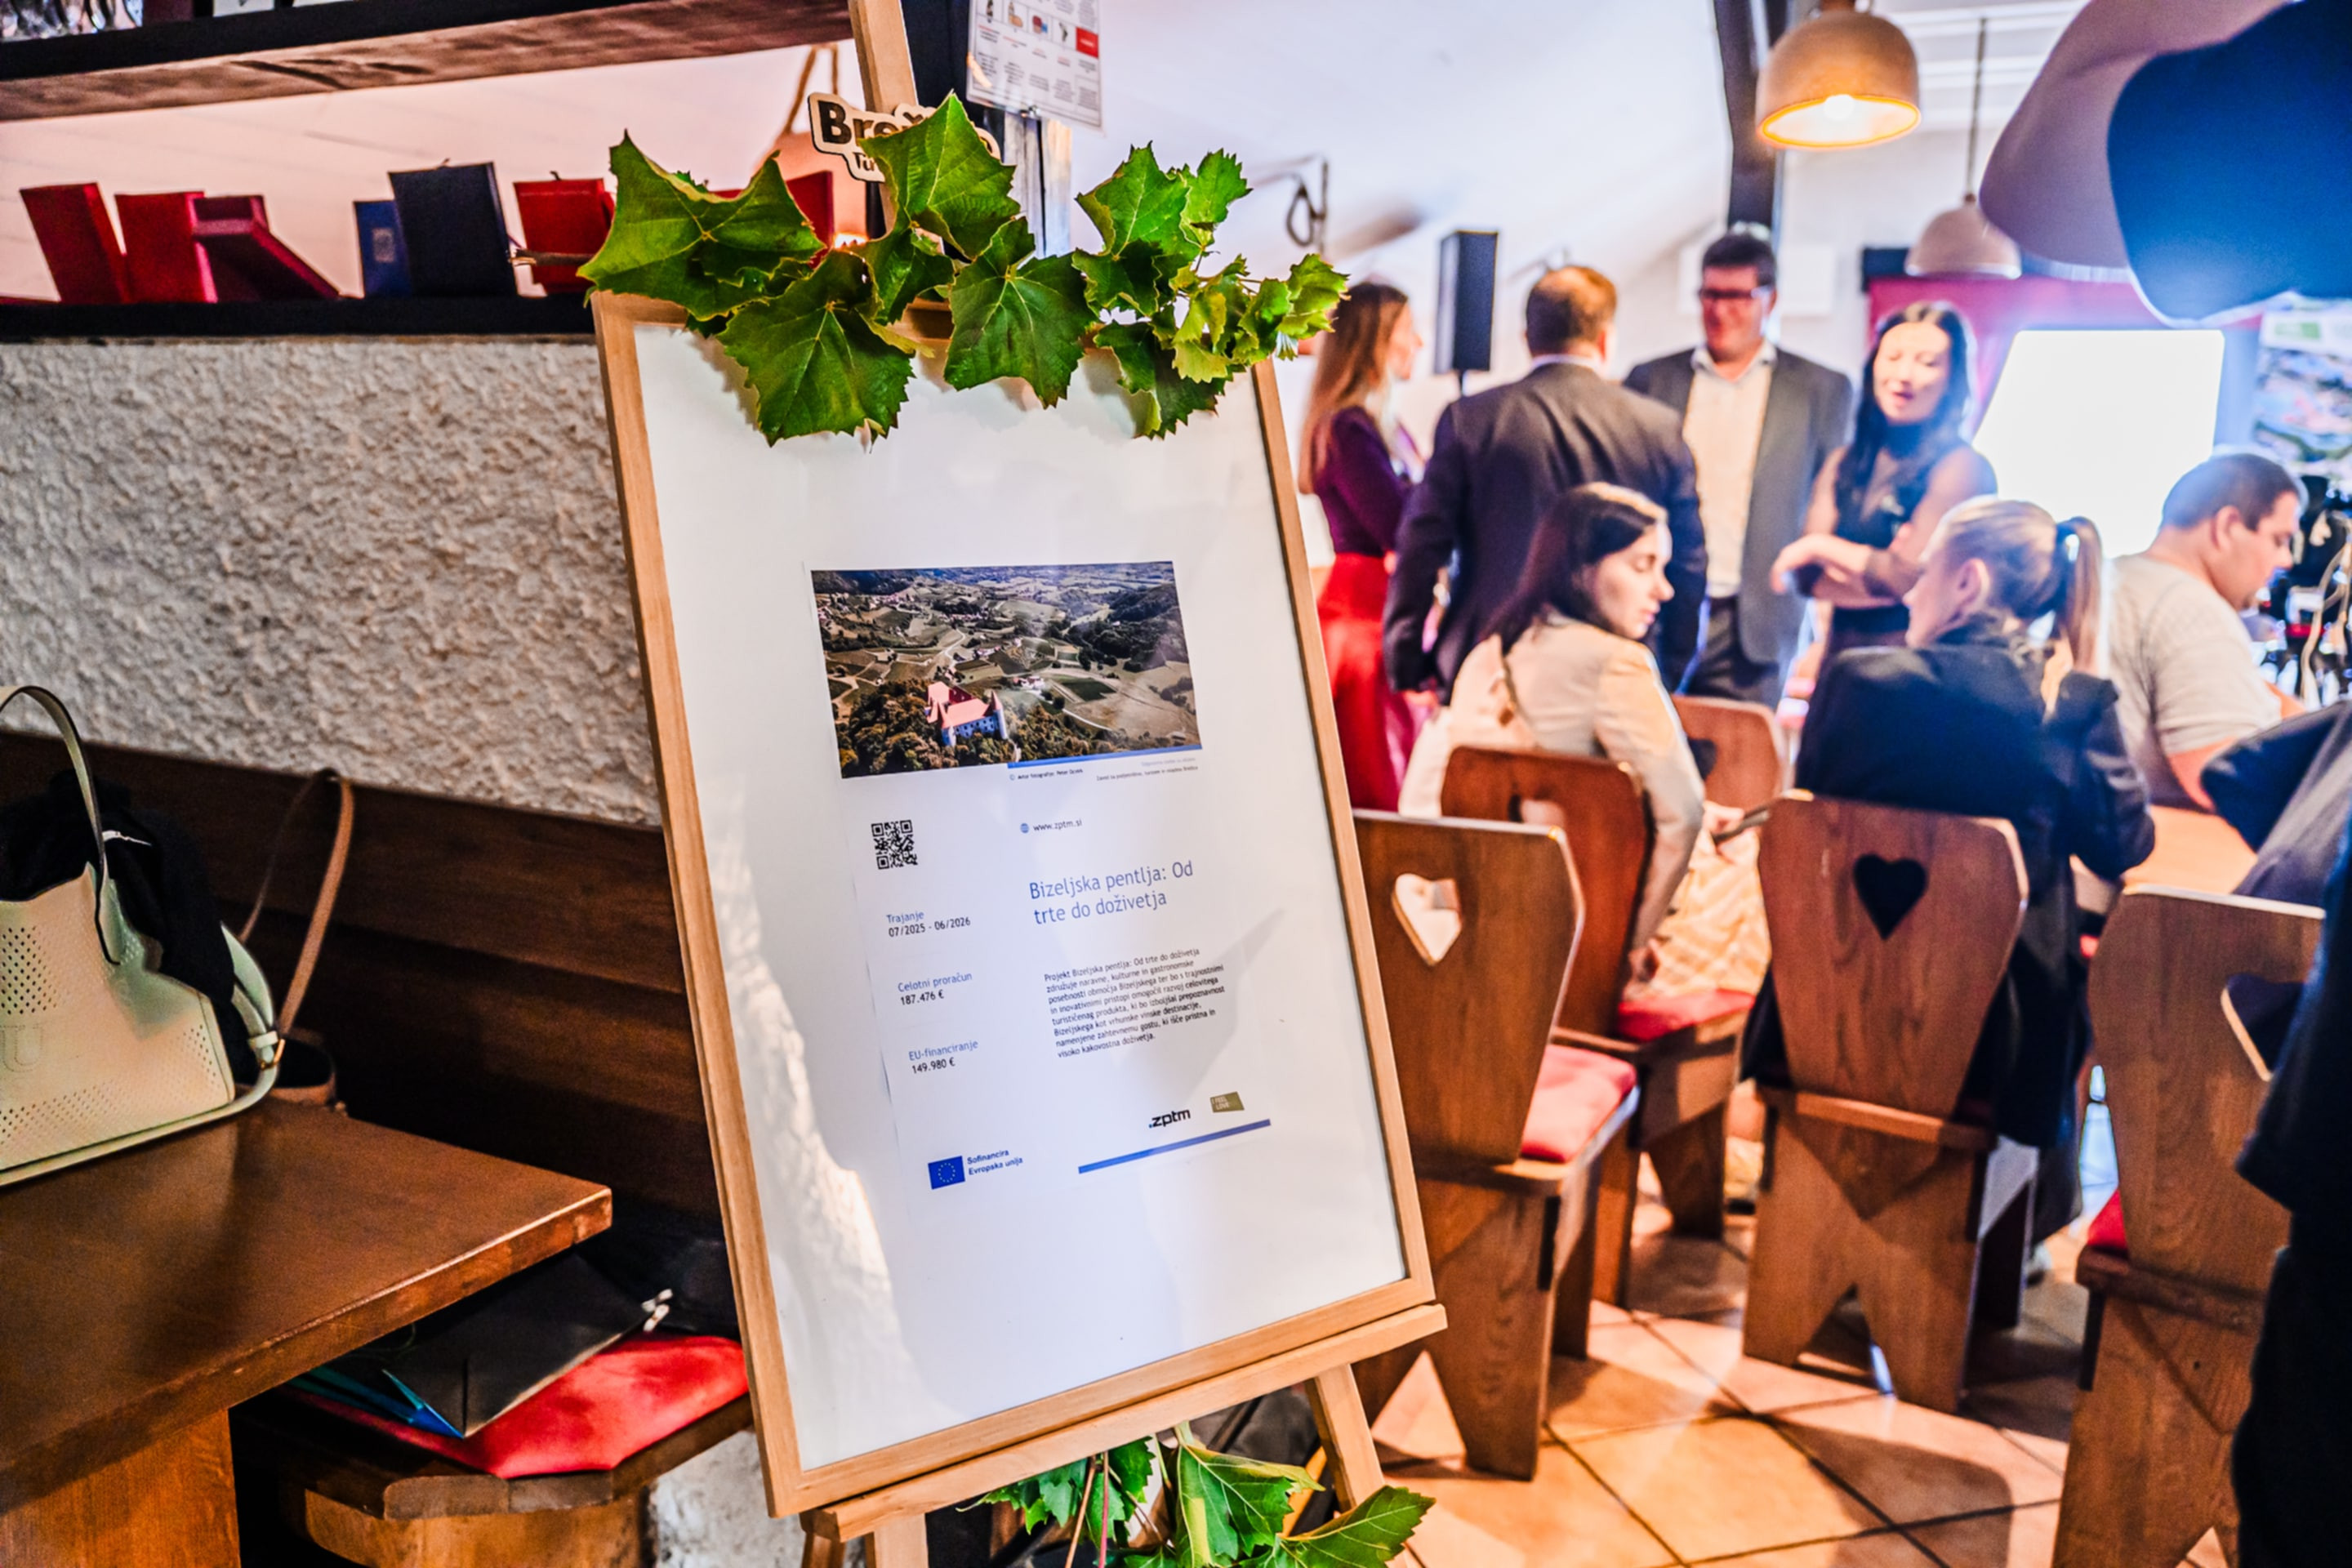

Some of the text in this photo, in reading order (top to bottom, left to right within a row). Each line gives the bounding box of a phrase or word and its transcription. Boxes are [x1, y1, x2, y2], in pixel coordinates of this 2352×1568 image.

[1033, 818, 1082, 832] www.zptm.si
[1029, 860, 1193, 899] Bizeljska pentlja: Od
[886, 911, 924, 924] Trajanje
[1034, 890, 1167, 924] trte do doživetja
[889, 923, 926, 938] 07/2025
[934, 916, 971, 930] 06/2026
[1045, 948, 1200, 982] Projekt Bizeljska pentlja: Od trte do doživetja
[898, 972, 973, 992] Celotni proračun
[1047, 981, 1077, 993] združuje
[1079, 977, 1110, 987] naravne,
[1111, 970, 1140, 981] kulturne
[1150, 960, 1194, 975] gastronomske
[1049, 991, 1086, 1004] posebnosti
[1088, 985, 1117, 996] območja
[1119, 978, 1156, 991] Bizeljskega
[1158, 975, 1168, 983] ter
[1169, 973, 1178, 981] bo
[1185, 964, 1223, 978] trajnostnimi
[901, 989, 944, 1005] 187.476 €
[1050, 977, 1218, 1014] in inovativnimi pristopi omogočil razvoj celovitega
[1095, 1004, 1129, 1018] produkta,
[1138, 1000, 1147, 1009] bo
[1149, 993, 1177, 1006] izboljšal
[1178, 986, 1225, 1001] prepoznavnost
[1054, 1022, 1094, 1036] Bizeljskega
[1095, 1019, 1107, 1028] kot
[1109, 1013, 1138, 1025] vrhunske
[1141, 1009, 1160, 1018] vinske
[1056, 1034, 1095, 1047] namenjene
[1098, 1026, 1138, 1039] zahtevnemu
[1170, 1013, 1183, 1023] išče
[1185, 1011, 1208, 1022] pristna
[1209, 1008, 1216, 1016] in
[909, 1040, 978, 1062] EU-financiranje
[1058, 1048, 1080, 1058] visoko
[1082, 1040, 1120, 1054] kakovostna
[912, 1057, 956, 1074] 149.980 €
[967, 1150, 1009, 1165] Sofinancira
[969, 1157, 1023, 1175] Evropska unija
